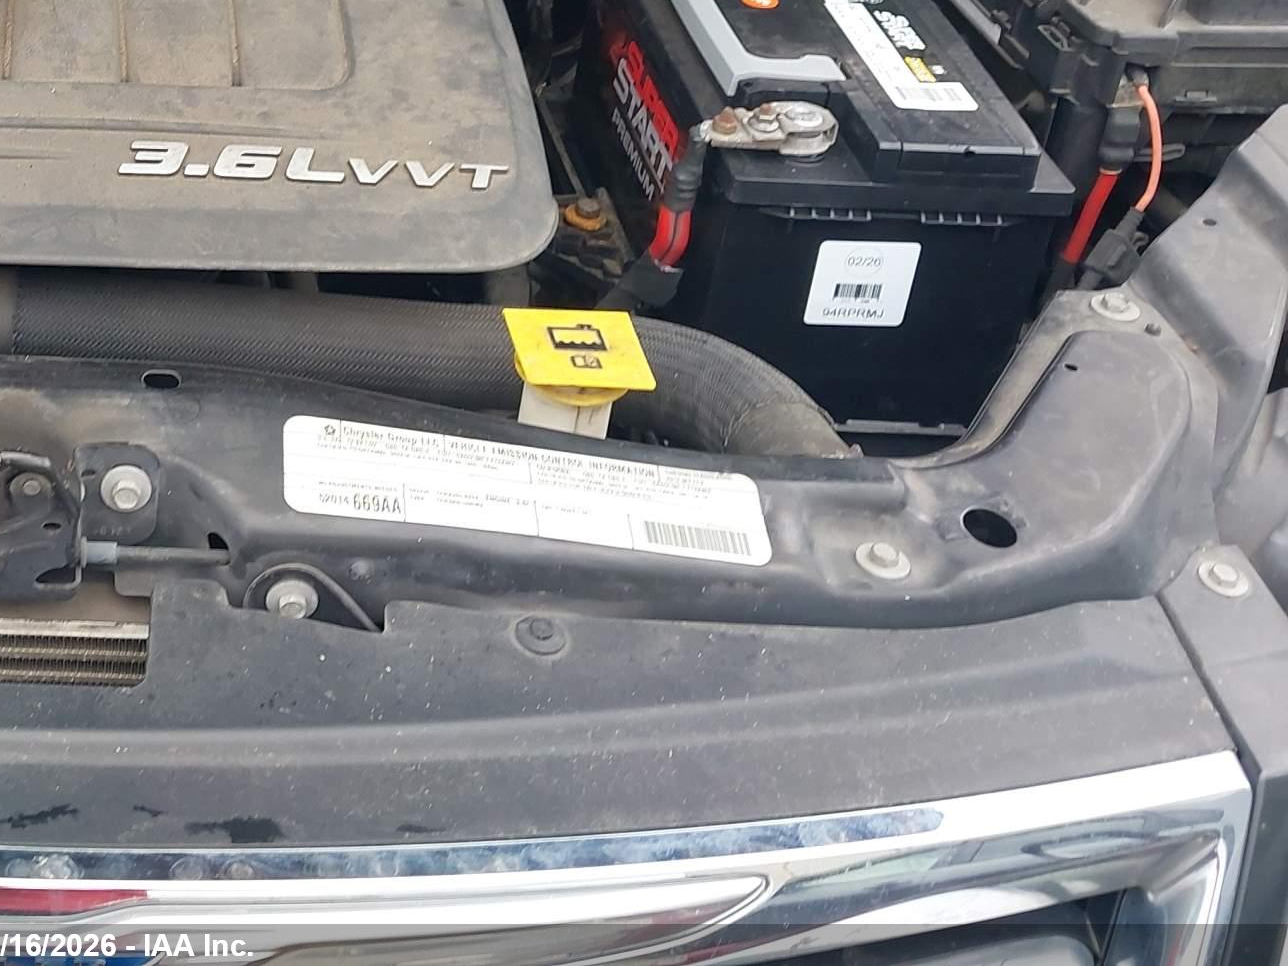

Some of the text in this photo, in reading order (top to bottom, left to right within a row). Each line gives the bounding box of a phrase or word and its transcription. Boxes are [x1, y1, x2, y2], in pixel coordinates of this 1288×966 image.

[611, 106, 656, 202] PREMIUM
[612, 57, 673, 181] START
[353, 493, 402, 514] 669AA
